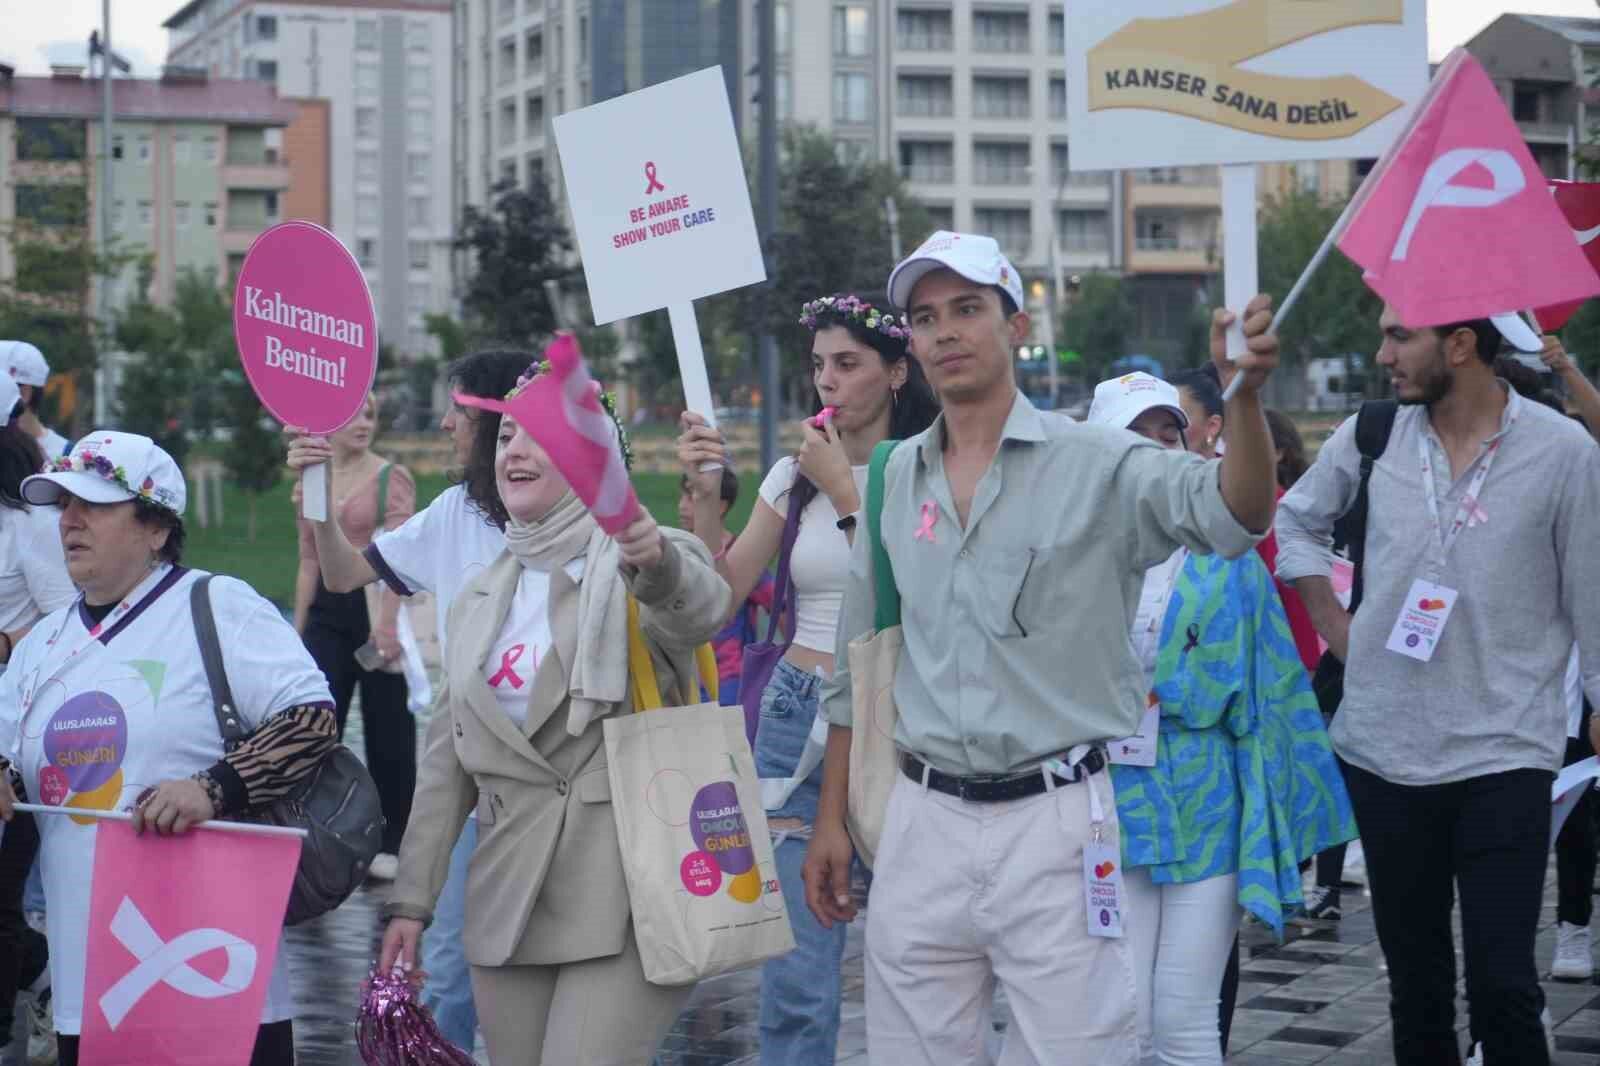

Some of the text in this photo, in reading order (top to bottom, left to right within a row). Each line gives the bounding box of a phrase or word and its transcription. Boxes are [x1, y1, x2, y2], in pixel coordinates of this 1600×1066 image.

[1105, 68, 1358, 125] KANSER SANA DEĞİL
[613, 207, 715, 248] SHOW YOUR CARE
[629, 194, 689, 223] BE AWARE
[244, 285, 364, 348] Kahraman
[265, 335, 346, 388] Benim!
